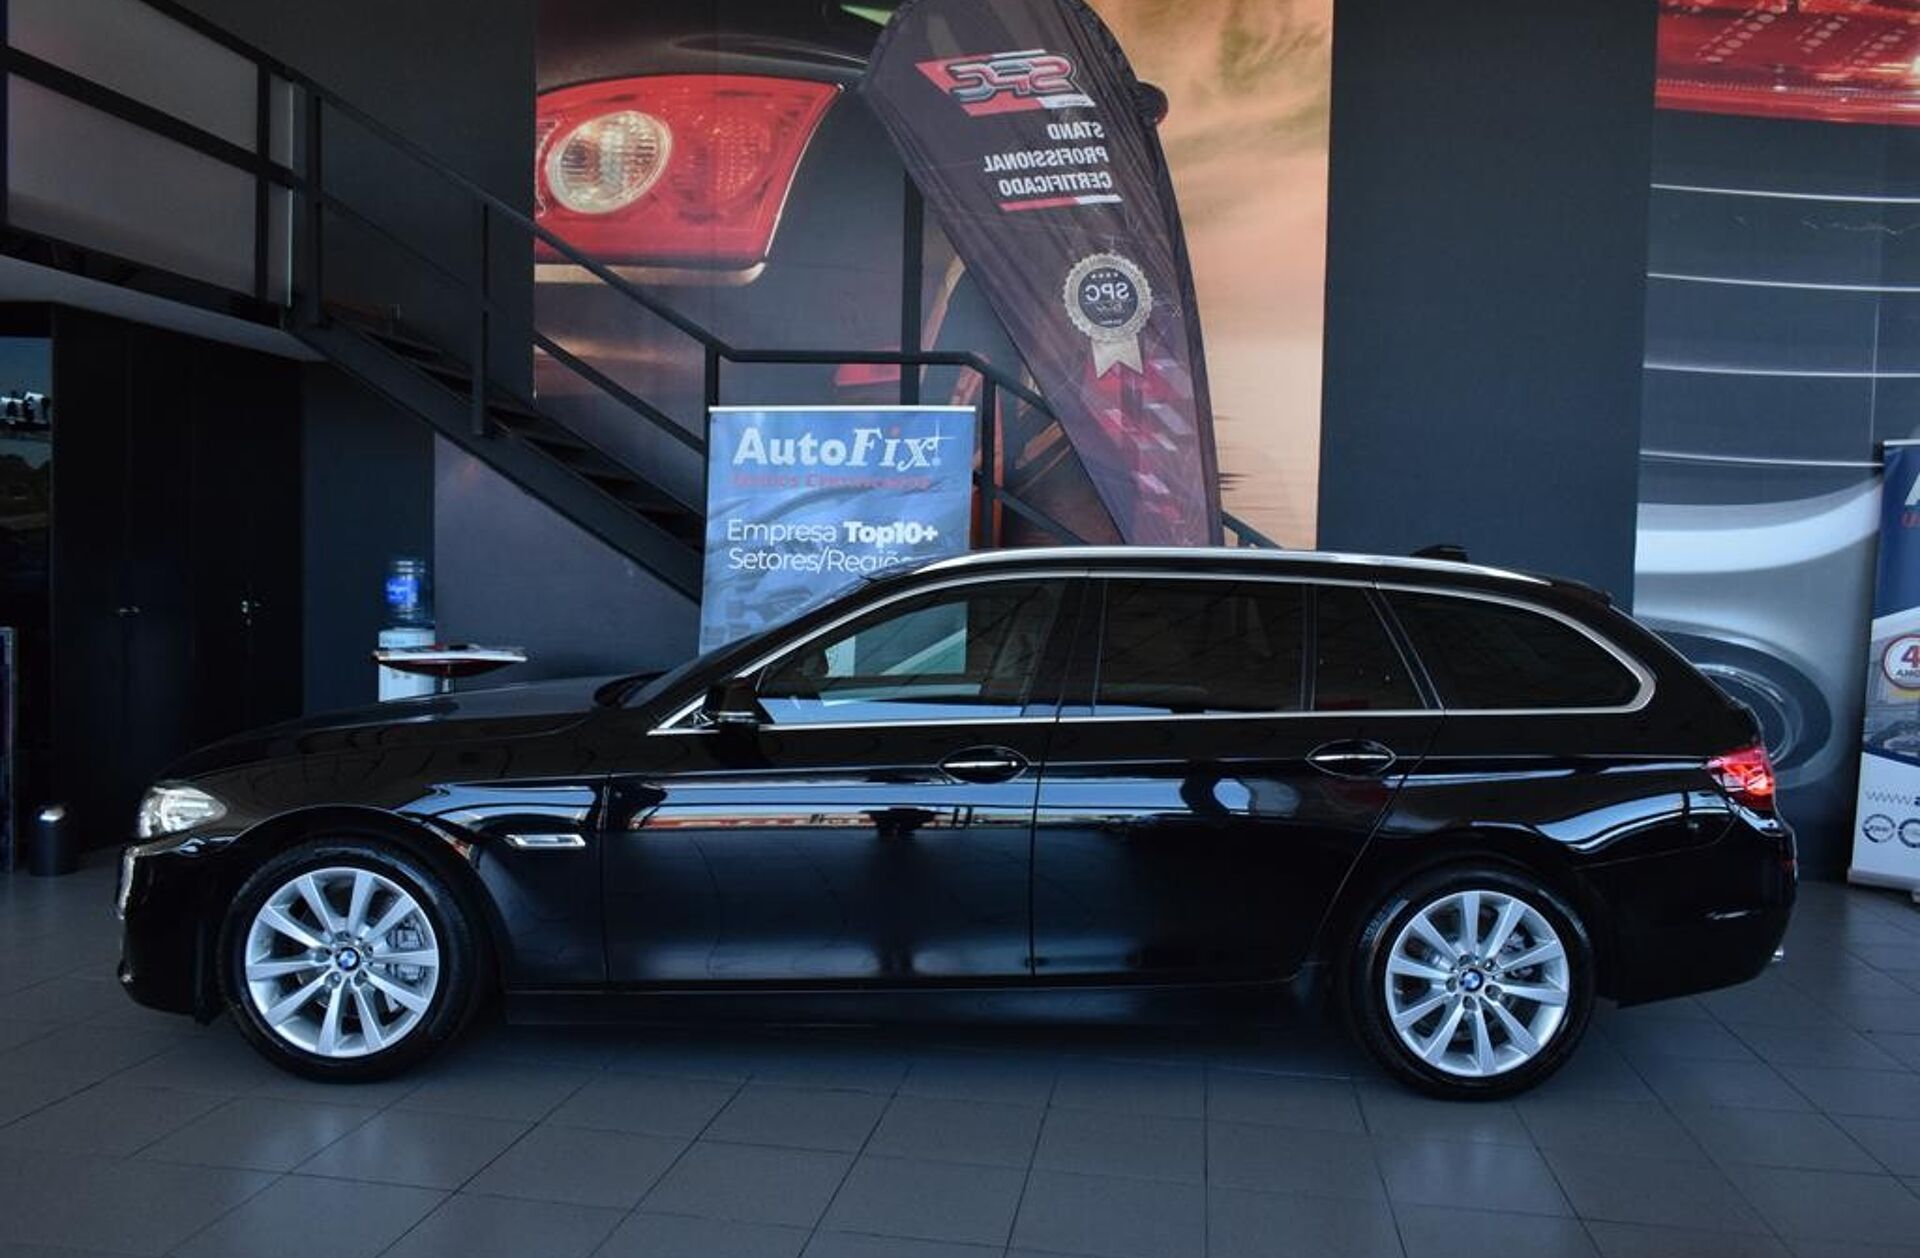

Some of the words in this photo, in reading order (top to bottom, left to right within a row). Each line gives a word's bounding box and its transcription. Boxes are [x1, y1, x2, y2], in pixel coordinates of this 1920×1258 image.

[732, 427, 931, 471] AutoFix
[727, 519, 837, 544] Empresa
[843, 520, 939, 548] Top10+
